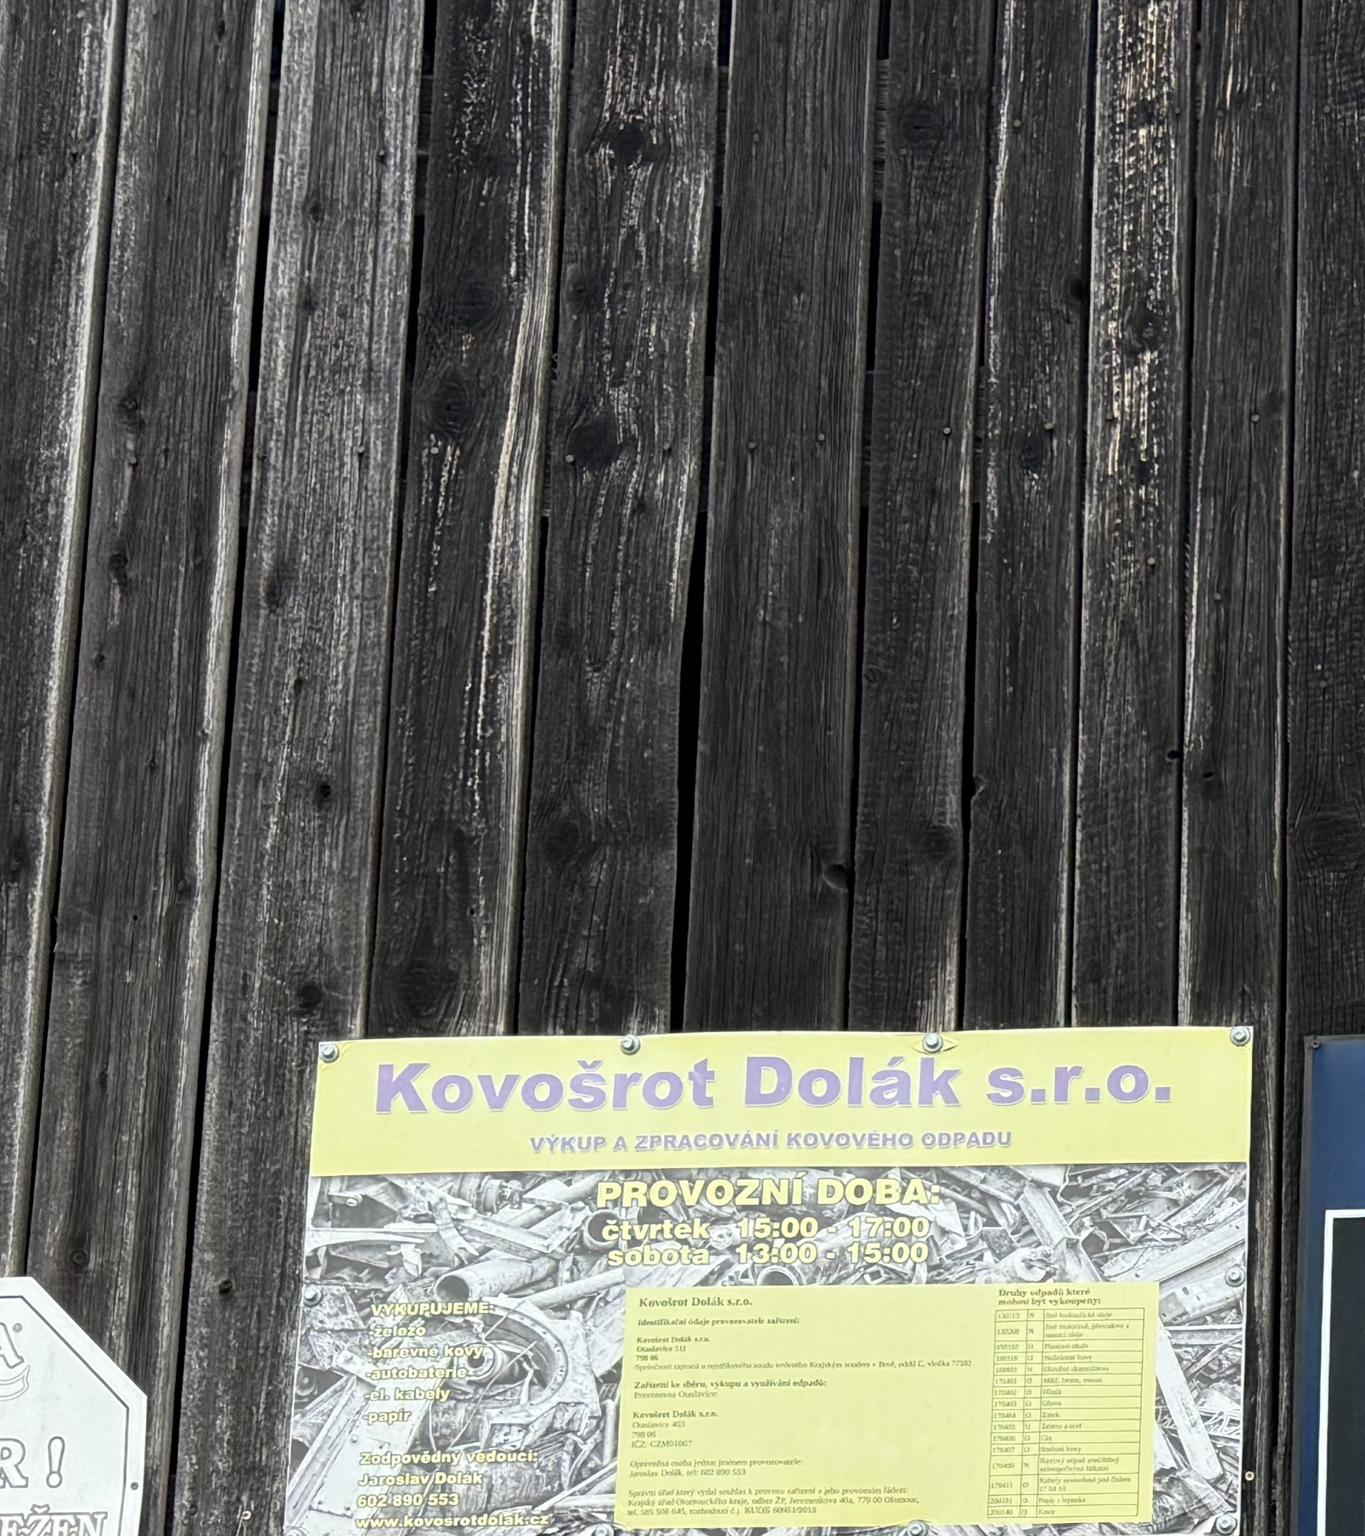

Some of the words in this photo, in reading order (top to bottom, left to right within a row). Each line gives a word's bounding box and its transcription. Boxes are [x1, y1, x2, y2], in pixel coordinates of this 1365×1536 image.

[375, 1057, 716, 1115] Kovošrot
[744, 1055, 961, 1107] Dolák
[987, 1063, 1172, 1106] s.r.o.
[530, 1133, 607, 1154] VÝKUP
[613, 1137, 628, 1152] A
[634, 1129, 779, 1152] ZPRACOVÁNÍ
[787, 1130, 914, 1149] KOVOVÉHO
[921, 1130, 1012, 1149] ODPADU
[596, 1172, 809, 1208] PROVOZNÍ
[817, 1177, 942, 1206] DOBA:
[602, 1217, 711, 1241] čtvrtek
[736, 1216, 819, 1239] 15:00
[849, 1216, 931, 1238] 17:00
[607, 1243, 711, 1266] sobota
[736, 1243, 818, 1265] 13:00
[848, 1242, 929, 1264] 15:00
[371, 1302, 496, 1316] VYKUPUJEME:
[692, 1296, 724, 1307] Dolák
[727, 1298, 753, 1307] s.r.o.
[396, 1387, 451, 1403] kabely
[359, 1450, 461, 1468] Zodpovědný
[358, 1473, 430, 1487] Jaroslav
[434, 1471, 483, 1486] Dolák
[357, 1494, 388, 1508] 602
[393, 1493, 421, 1507] 890
[428, 1492, 459, 1507] 553
[356, 1513, 550, 1529] www.kovosrotdolak.cz
